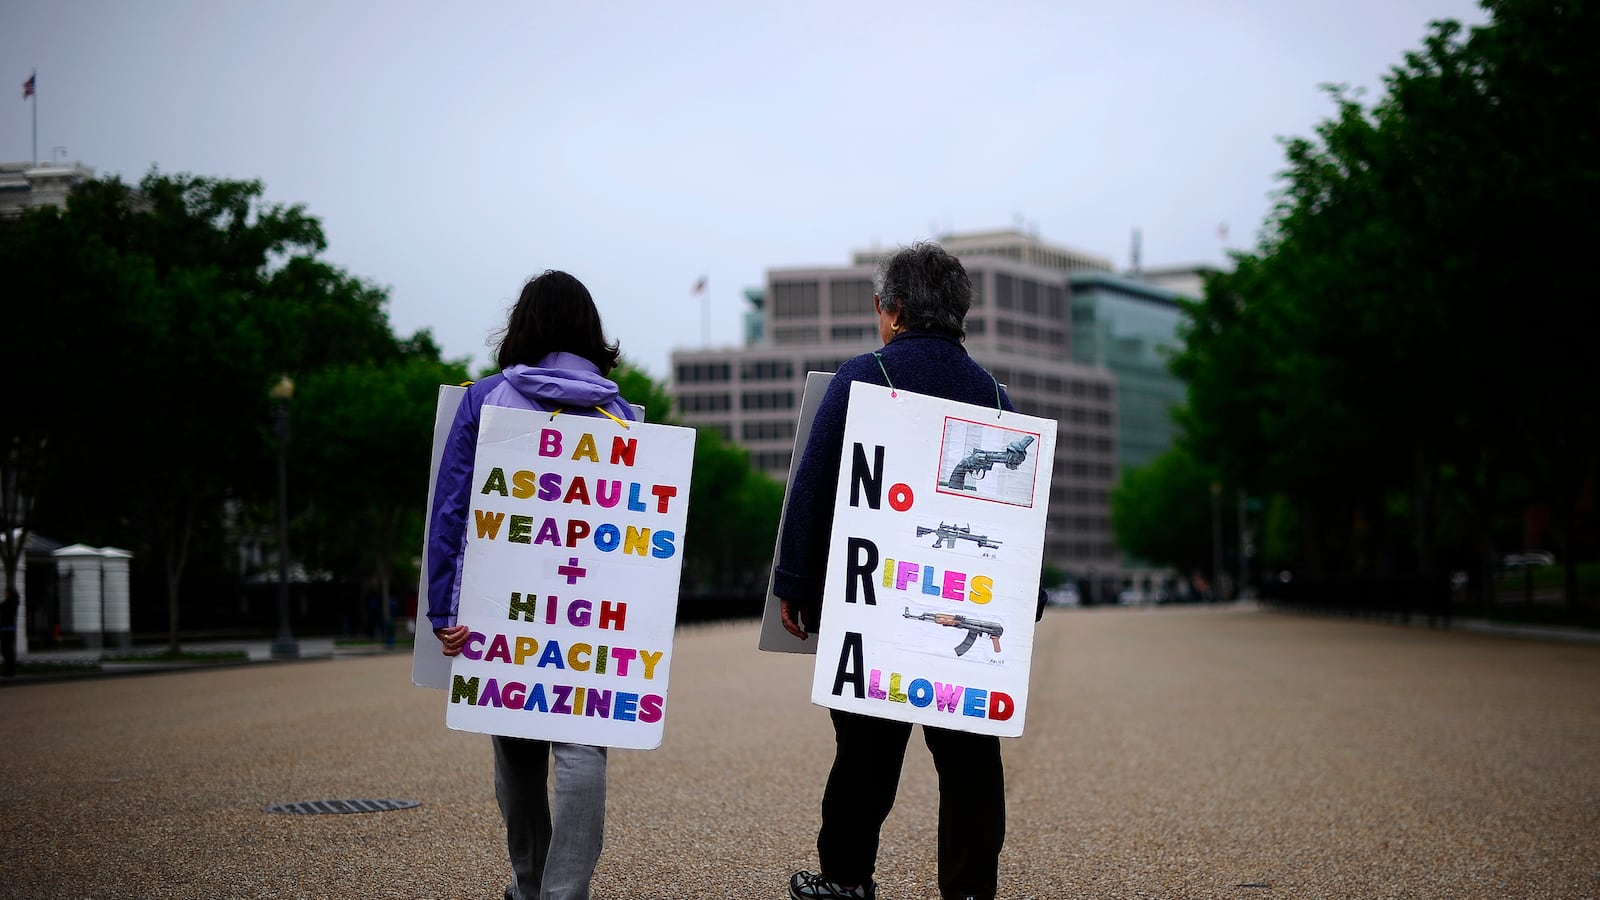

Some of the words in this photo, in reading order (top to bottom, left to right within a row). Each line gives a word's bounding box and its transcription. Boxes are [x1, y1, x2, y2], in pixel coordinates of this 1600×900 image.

[538, 428, 638, 467] BAN
[481, 467, 677, 514] ASSAULT
[474, 509, 676, 559] WEAPONS
[558, 557, 587, 585] +
[845, 536, 994, 606] RIFLES
[508, 592, 627, 631] HIGH
[460, 631, 663, 680] CAPACITY
[831, 631, 1015, 721] ALLOWED
[451, 674, 664, 723] MAGAZINES
